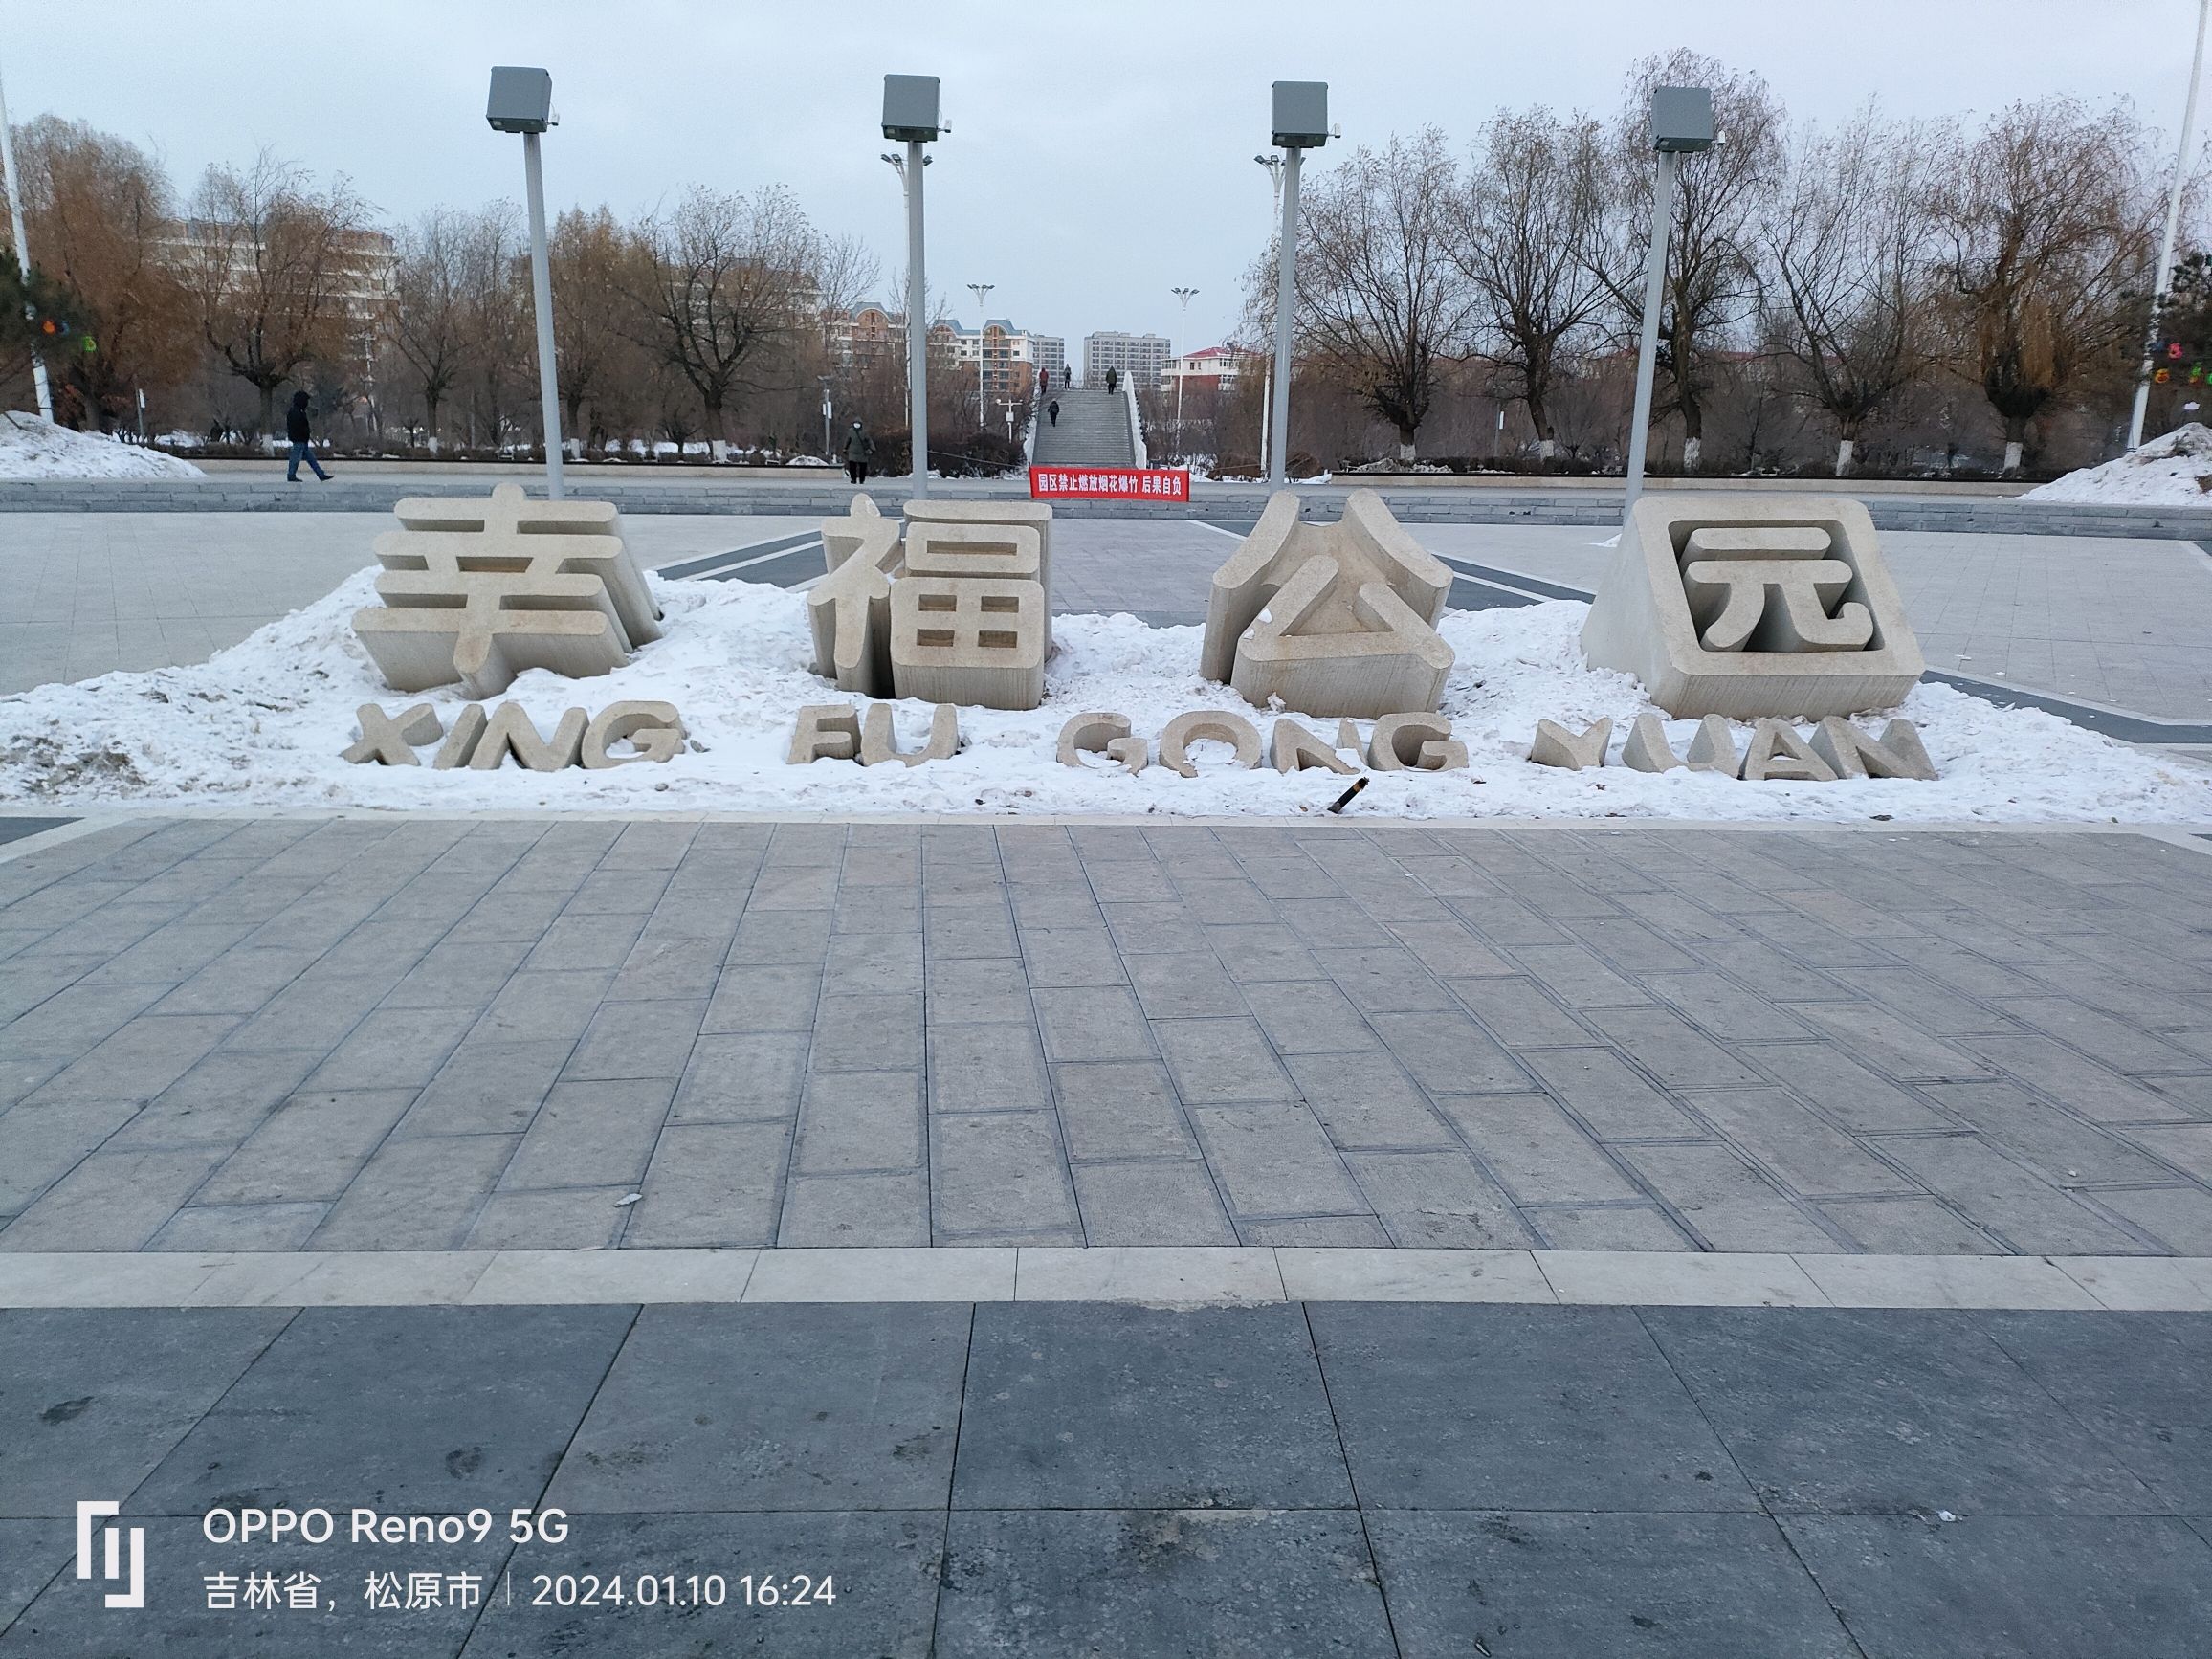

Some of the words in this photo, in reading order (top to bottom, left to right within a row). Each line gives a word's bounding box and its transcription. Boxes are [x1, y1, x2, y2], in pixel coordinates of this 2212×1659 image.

[1038, 473, 1138, 493] 园区禁止燃放烟花爆竹
[1141, 476, 1182, 496] 后果自负
[339, 700, 686, 771] XING
[786, 702, 960, 767] FU
[1056, 710, 1470, 778] GONG
[1531, 712, 1939, 782] YUAN
